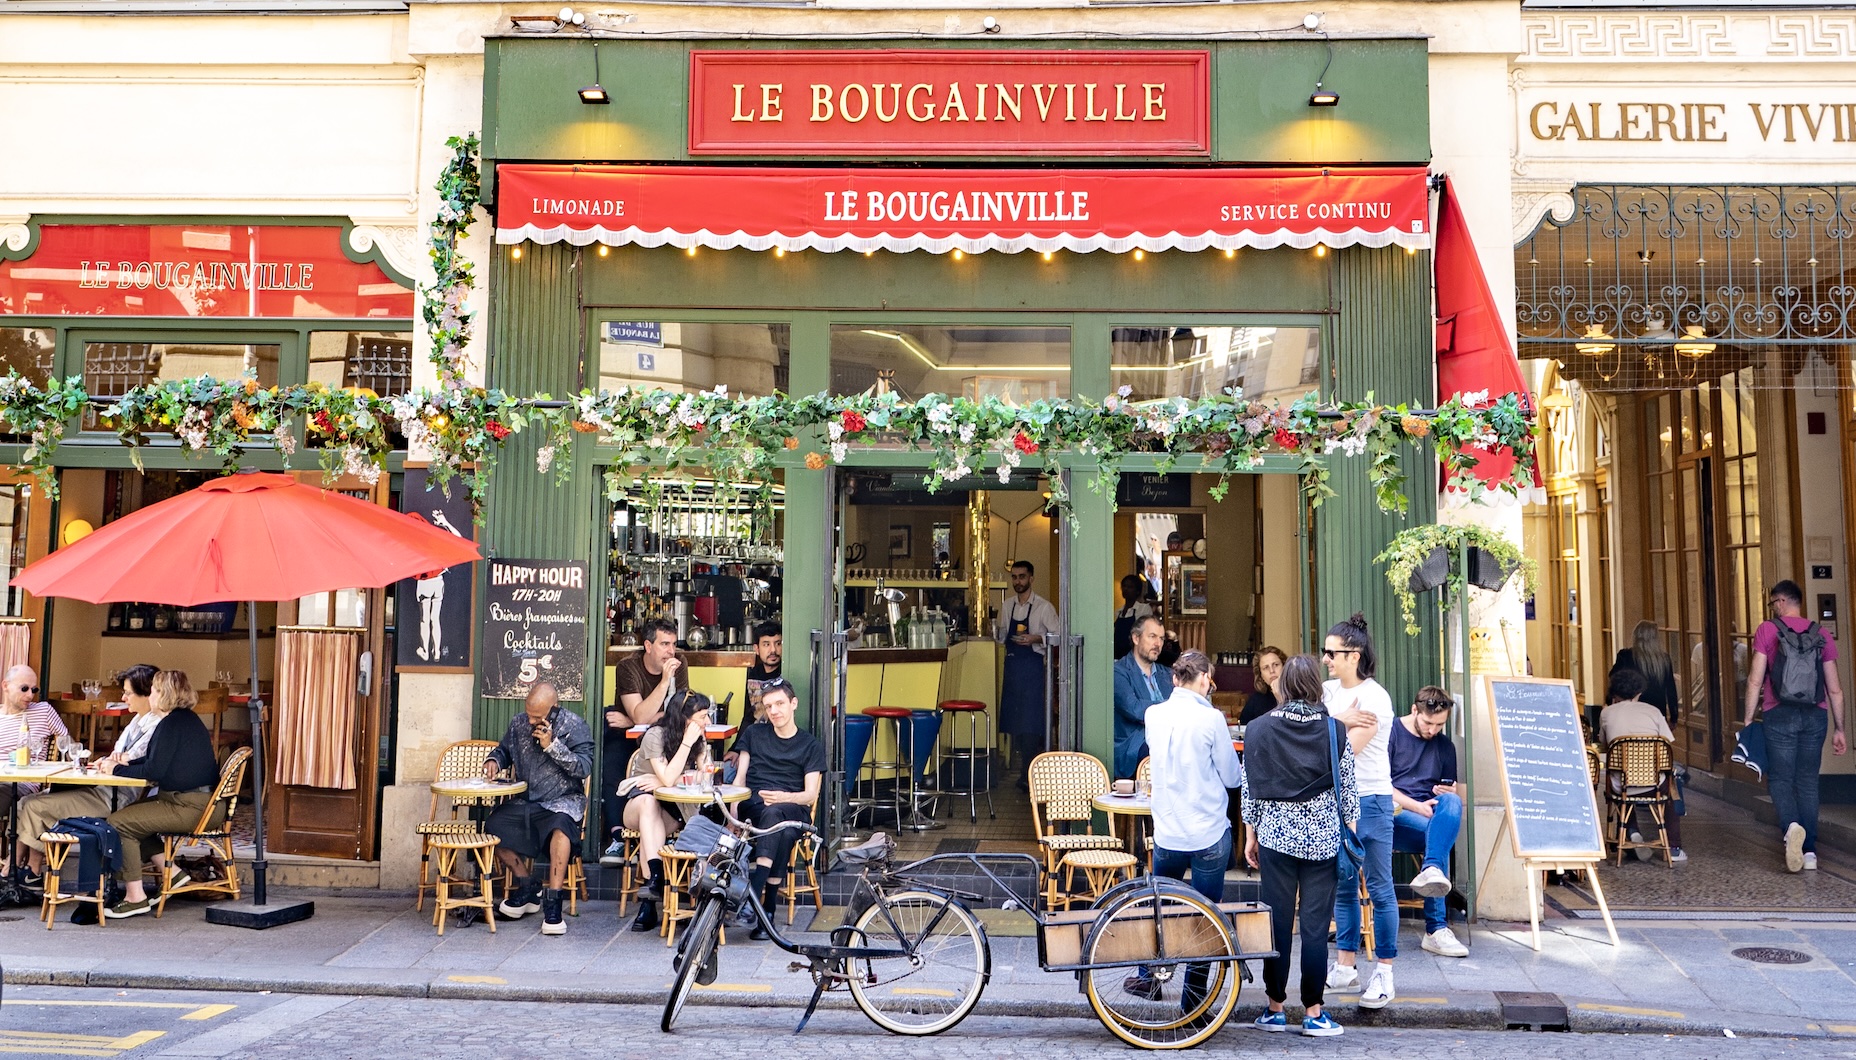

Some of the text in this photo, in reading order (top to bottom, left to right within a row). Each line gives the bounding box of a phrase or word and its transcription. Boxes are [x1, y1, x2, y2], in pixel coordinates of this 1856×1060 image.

[731, 82, 1167, 122] LE BOUGAINVILLE
[1529, 101, 1728, 142] GALERIE
[533, 198, 625, 216] LIMONADE
[824, 190, 1089, 222] LE BOUGAINVILLE
[1220, 202, 1392, 222] SERVICE CONTINU
[79, 261, 314, 290] LE BOUGAINVILLE
[492, 563, 584, 589] HAPPY HOUR
[1819, 568, 1826, 577] 2
[511, 588, 563, 602] 17H-20H
[489, 601, 523, 622] Bières
[523, 606, 574, 630] françaises
[503, 629, 563, 652] Cocktails
[1285, 712, 1301, 721] VOID
